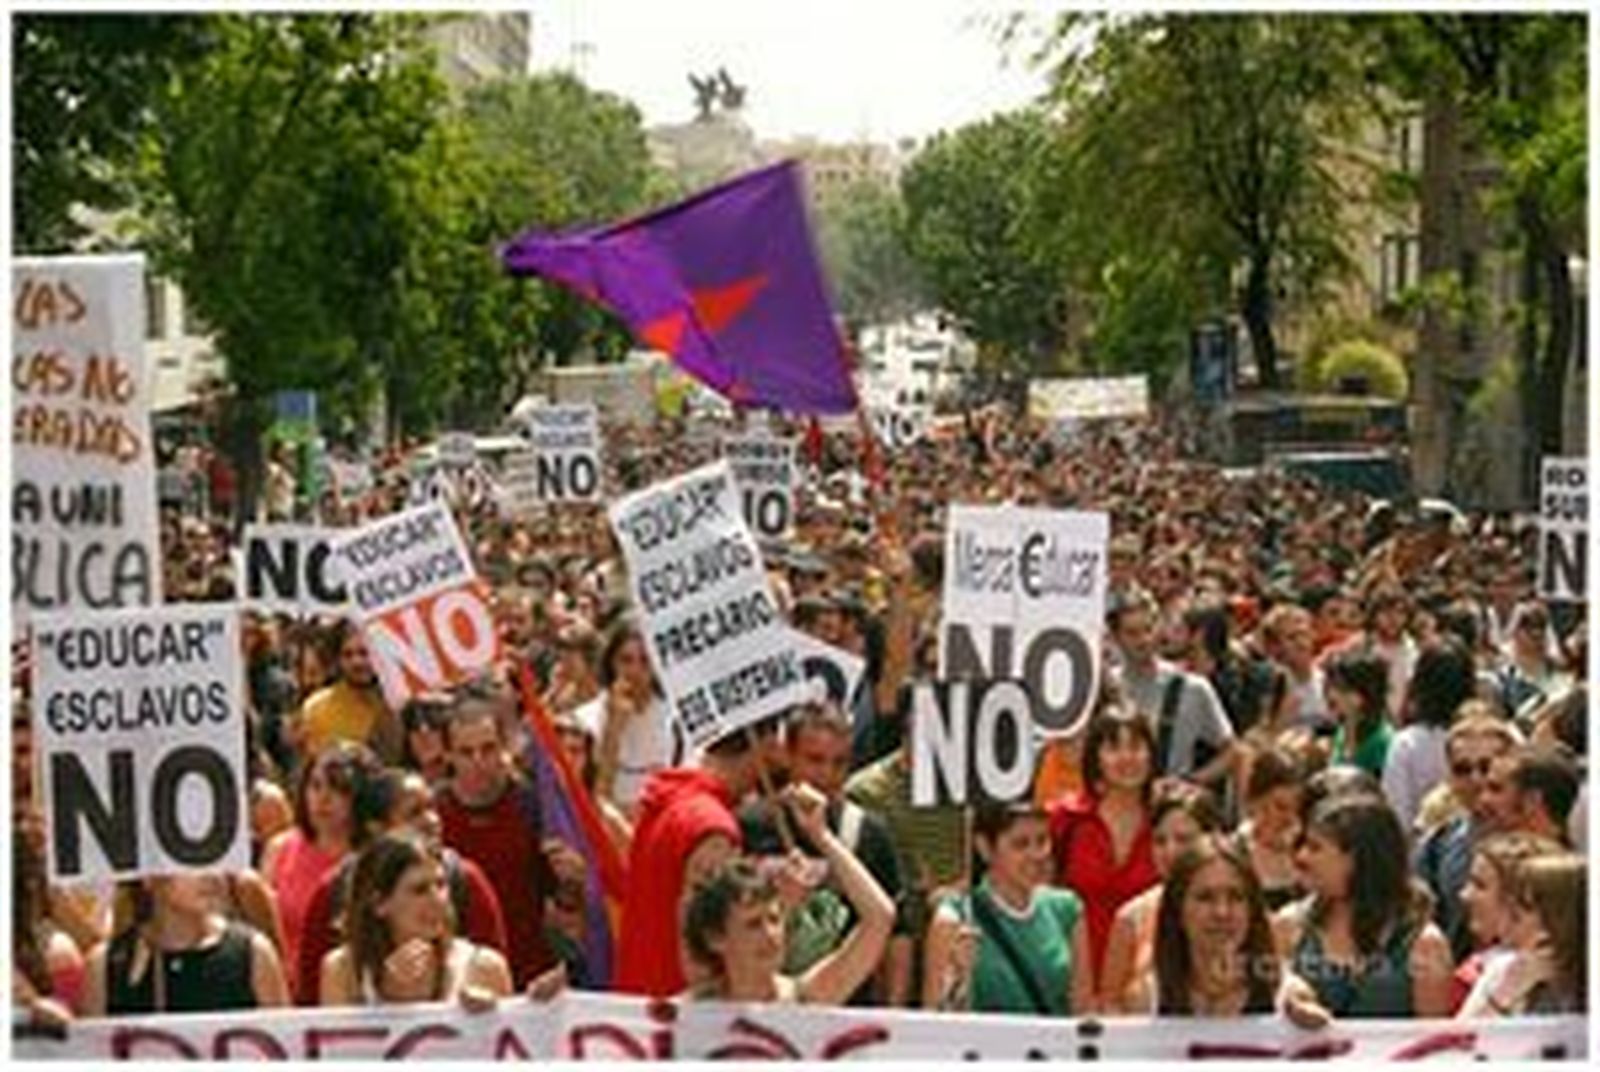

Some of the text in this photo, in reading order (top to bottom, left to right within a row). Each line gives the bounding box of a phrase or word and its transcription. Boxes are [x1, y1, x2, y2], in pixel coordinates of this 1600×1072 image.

[538, 454, 597, 499] NO
[366, 588, 494, 711] NO
[911, 680, 1032, 807] NO
[51, 744, 240, 876] NO
